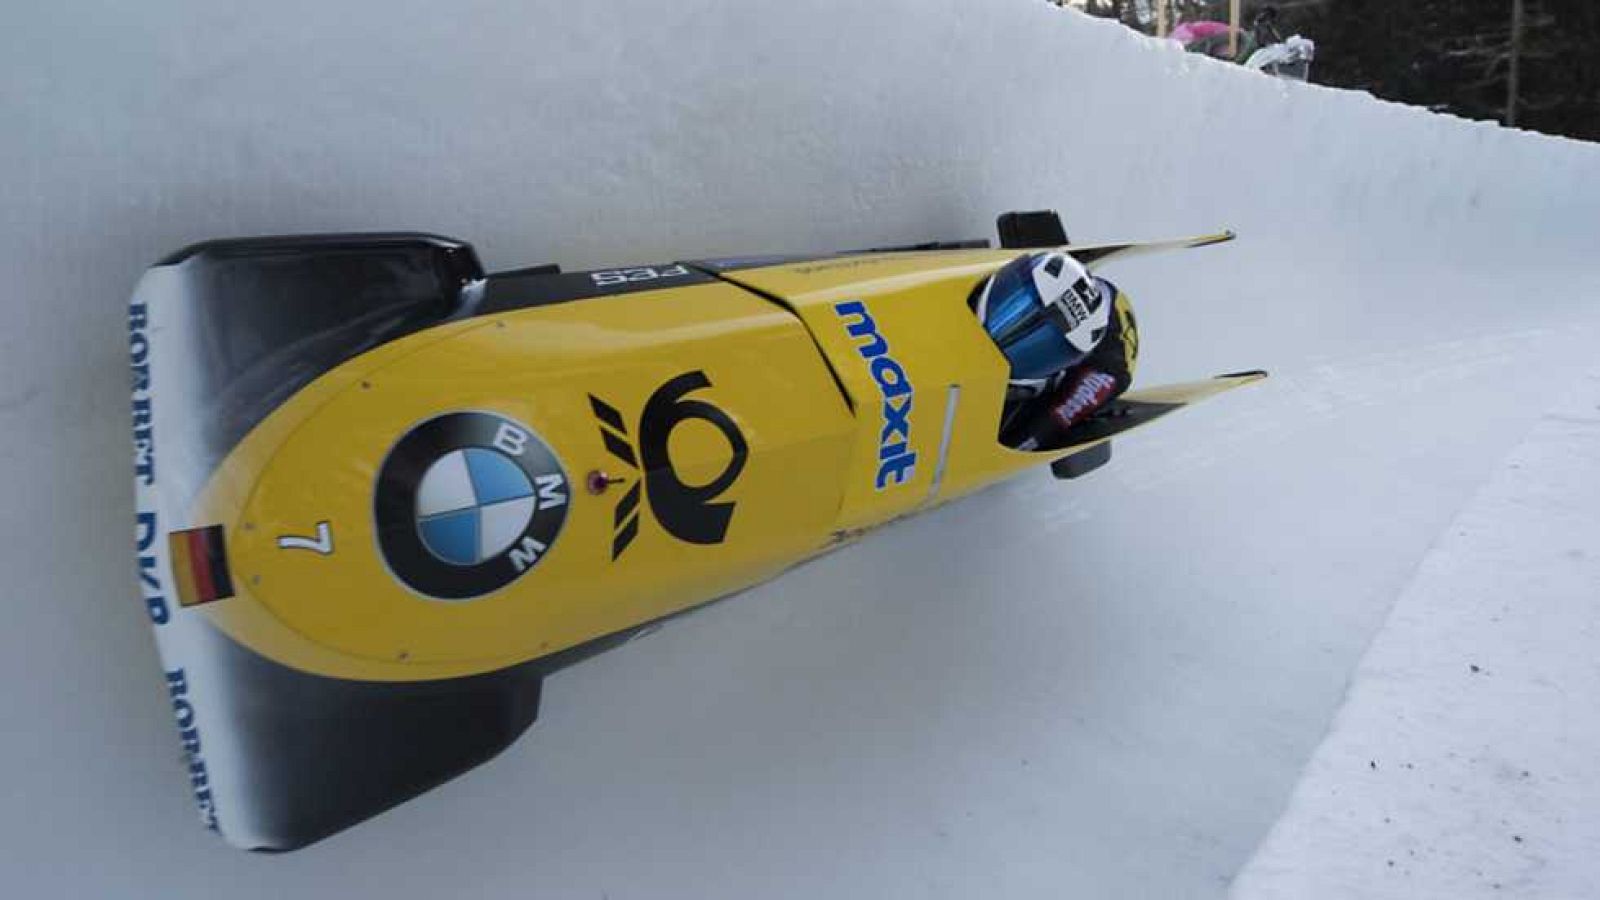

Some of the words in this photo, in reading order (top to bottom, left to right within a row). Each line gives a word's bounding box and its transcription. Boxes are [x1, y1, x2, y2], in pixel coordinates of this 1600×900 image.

[834, 301, 917, 490] maxit
[276, 520, 333, 556] 7
[493, 422, 567, 573] BMW
